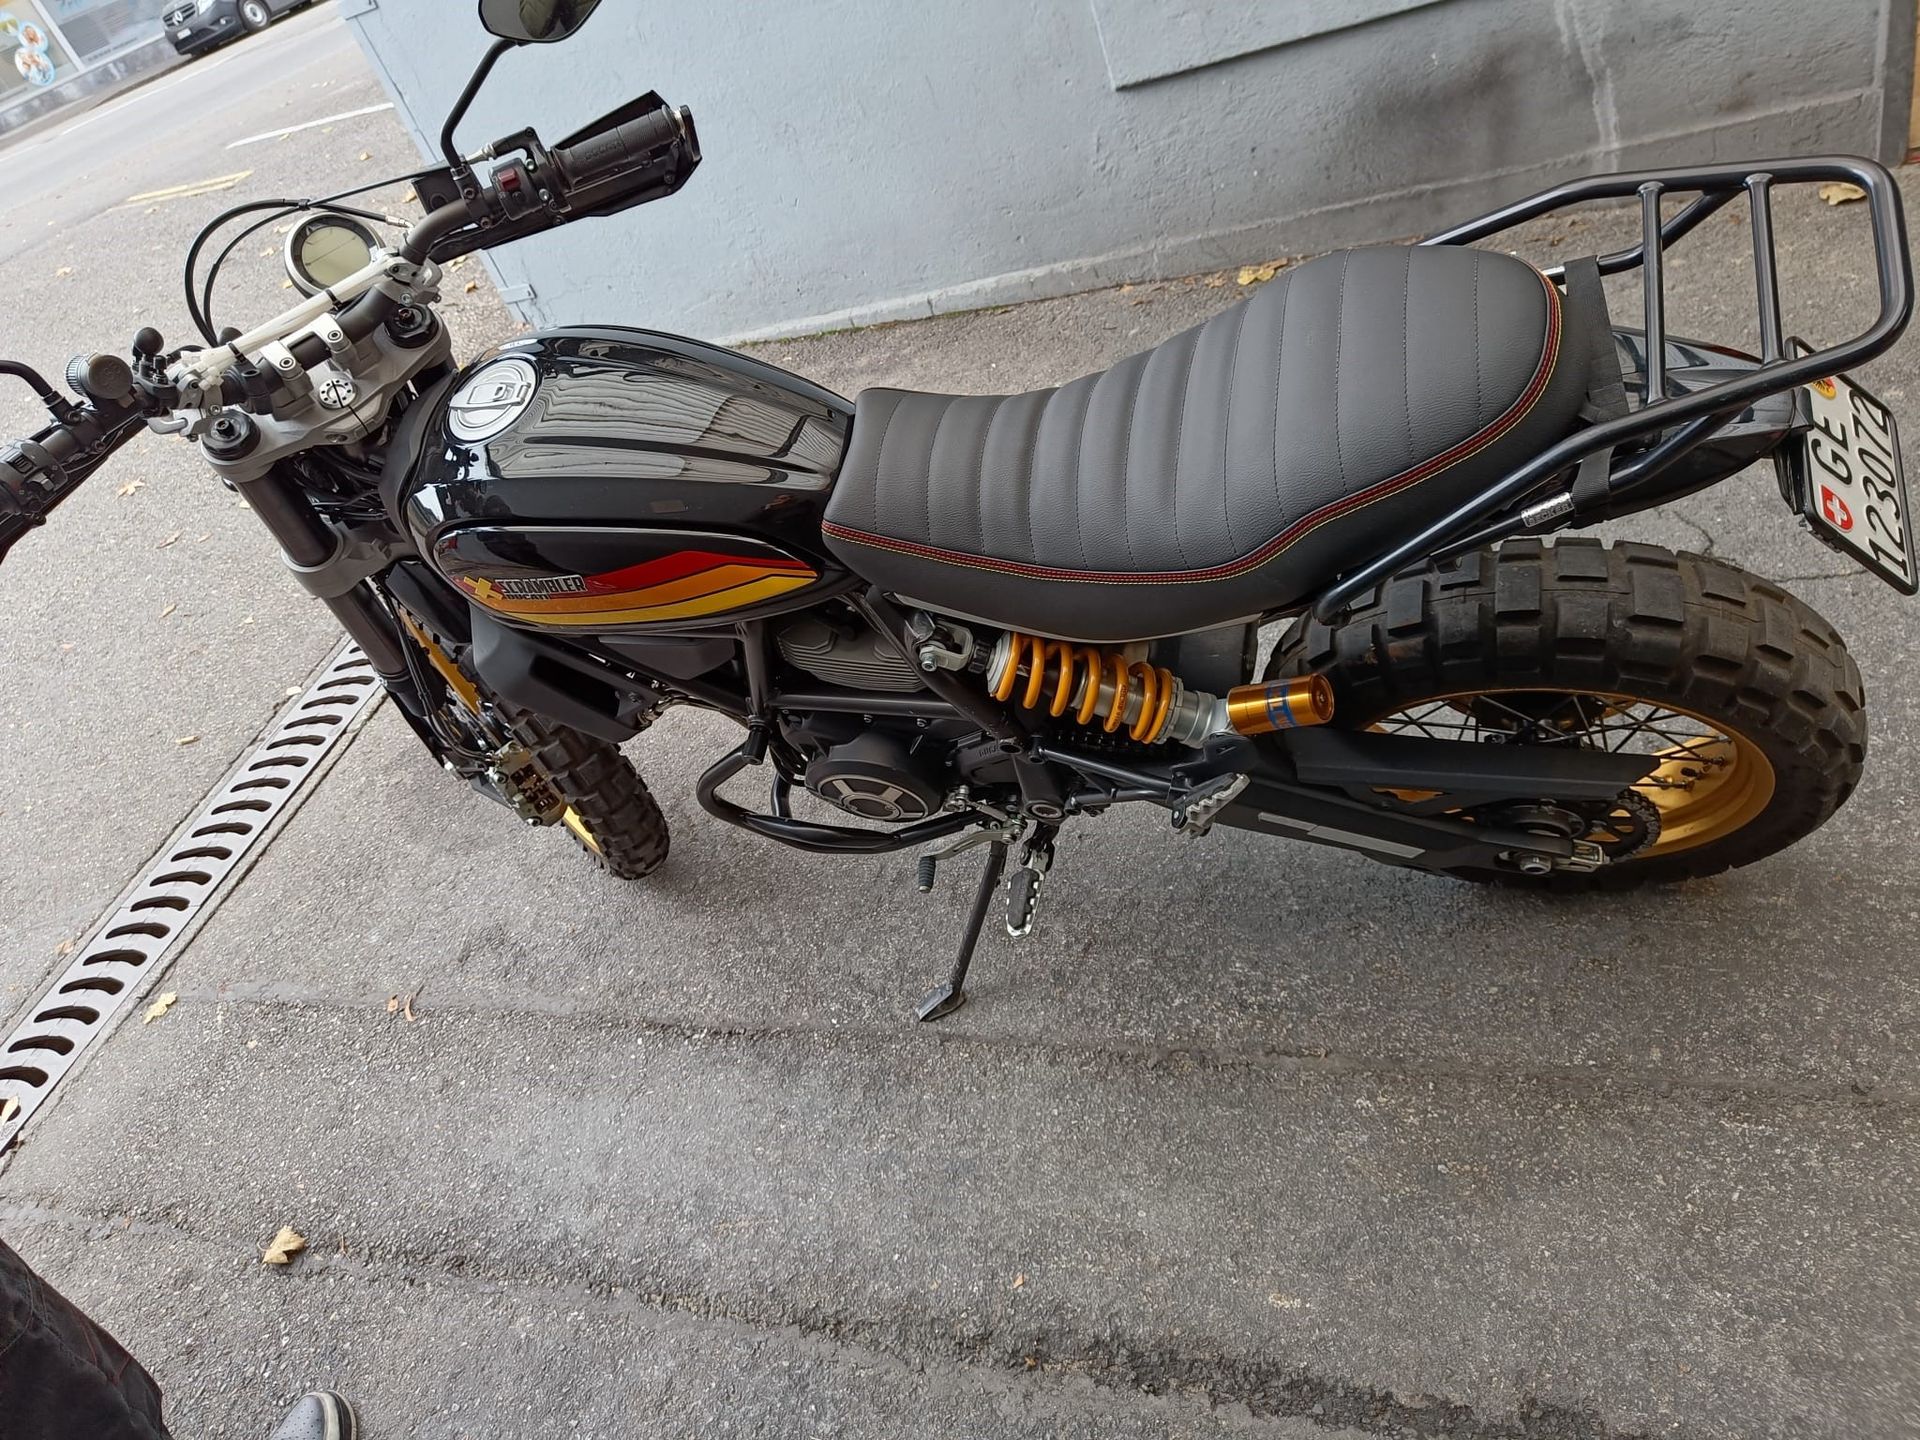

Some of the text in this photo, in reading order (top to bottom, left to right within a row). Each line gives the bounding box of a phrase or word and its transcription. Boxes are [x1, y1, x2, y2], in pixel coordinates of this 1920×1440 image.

[1811, 415, 1852, 485] GE
[1849, 388, 1908, 578] 123072
[495, 575, 588, 594] SCRAMBLER
